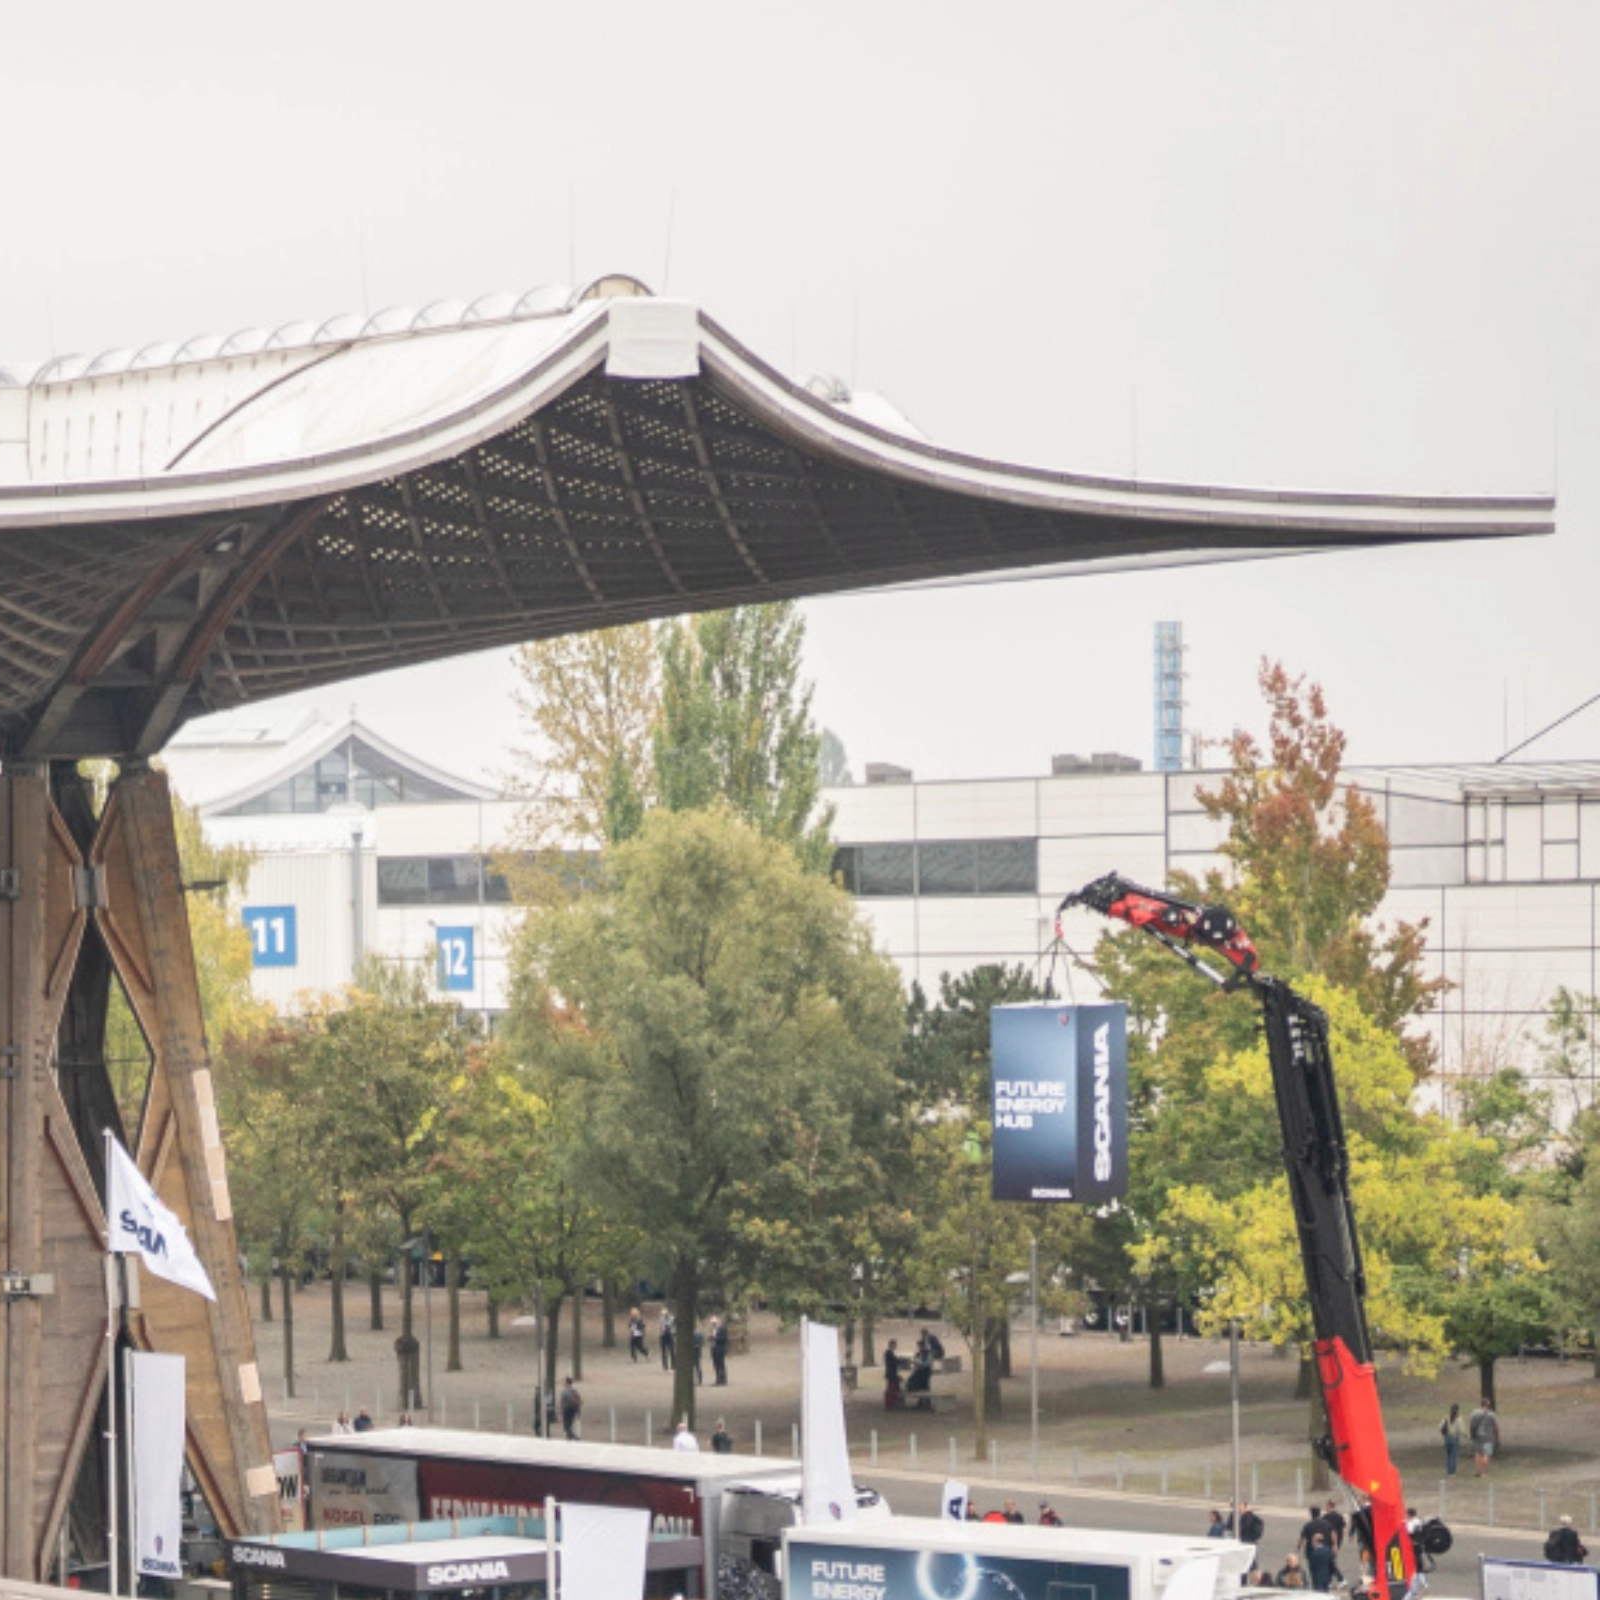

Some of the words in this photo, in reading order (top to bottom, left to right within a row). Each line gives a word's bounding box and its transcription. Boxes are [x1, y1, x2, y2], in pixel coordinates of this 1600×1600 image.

[252, 916, 286, 954] 11
[440, 937, 468, 976] 12
[995, 1080, 1066, 1097] FUTURE
[995, 1097, 1067, 1114] ENERGY
[1093, 1022, 1112, 1181] SCANIA
[995, 1114, 1033, 1129] HUB
[232, 1545, 286, 1568] SCANIA
[427, 1560, 509, 1587] SCANIA
[811, 1560, 886, 1583] FUTURE
